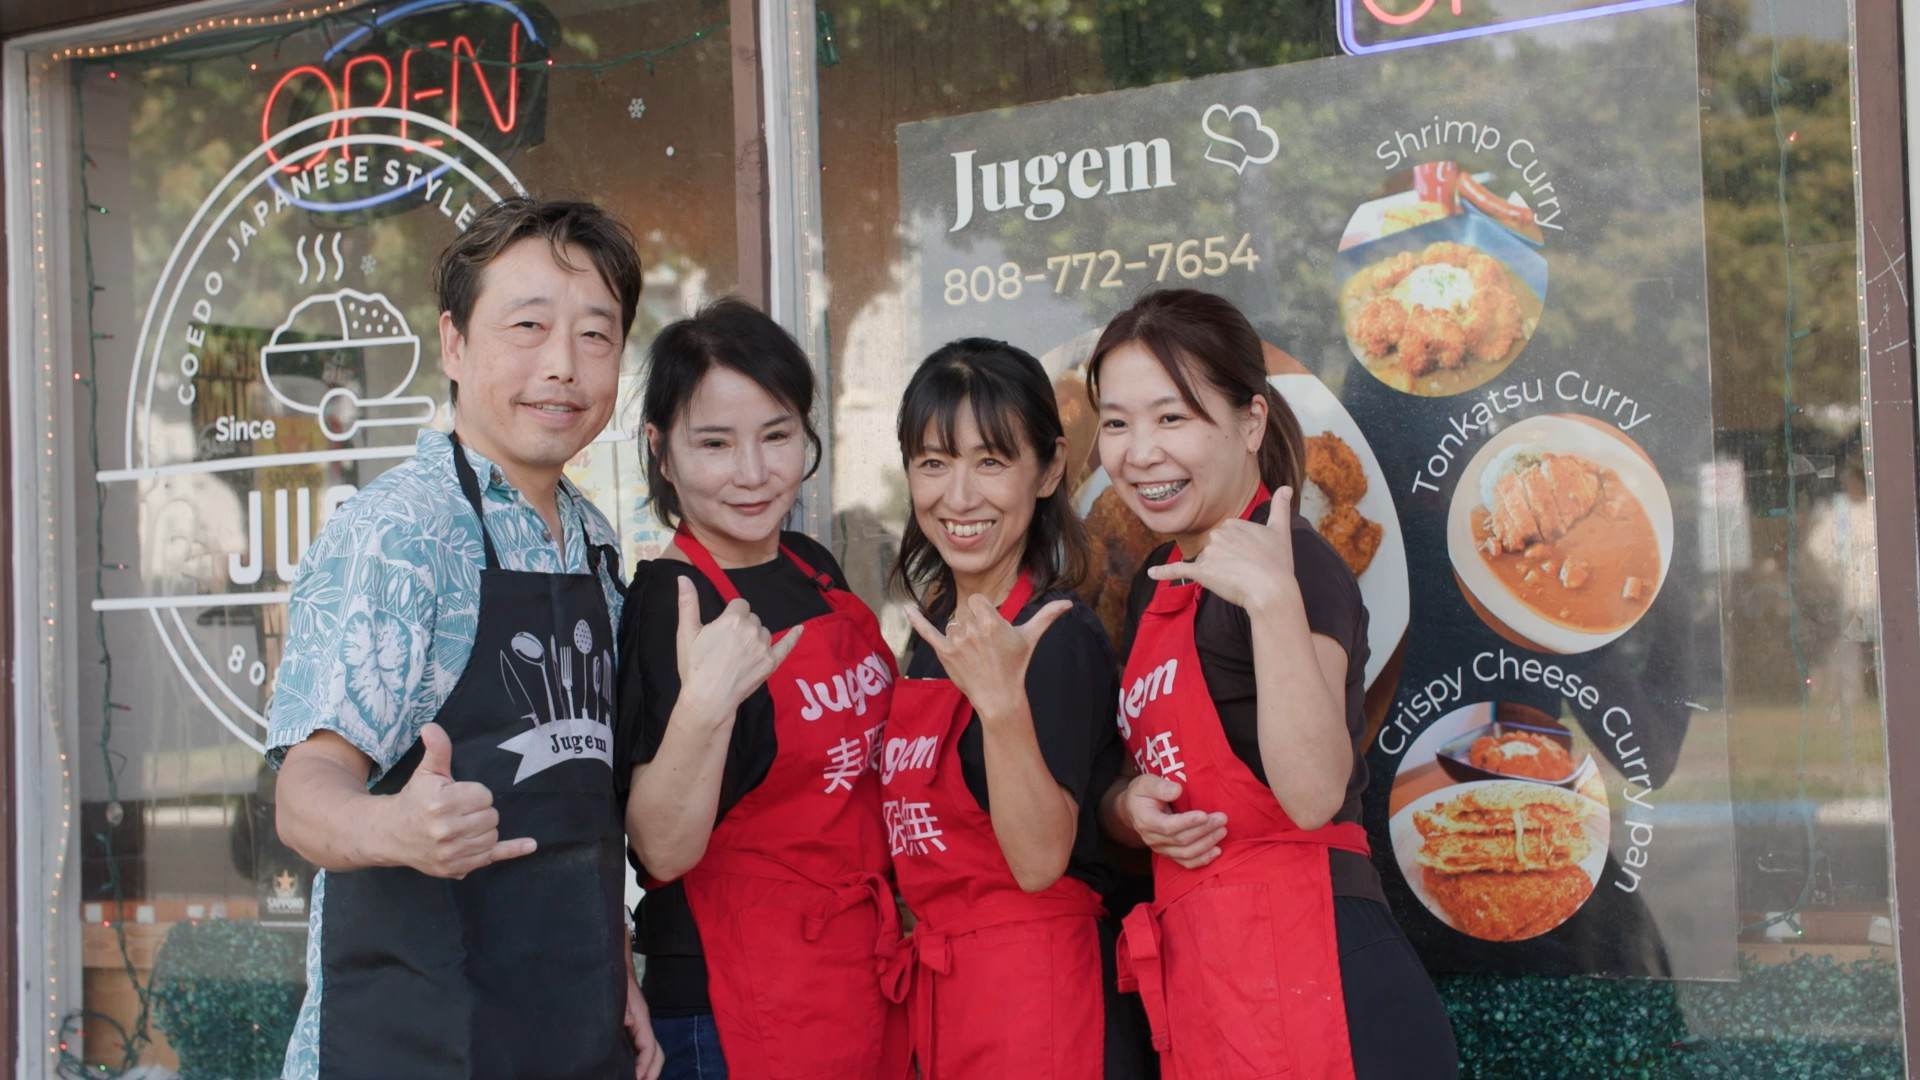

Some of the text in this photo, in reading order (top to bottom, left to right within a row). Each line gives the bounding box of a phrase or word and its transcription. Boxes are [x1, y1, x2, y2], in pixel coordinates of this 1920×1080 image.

[261, 21, 519, 174] OPEN
[949, 137, 1176, 232] Jugem
[1376, 115, 1564, 231] Shrimp Curry
[177, 156, 477, 405] COEDO JAPANESE STYLE
[943, 232, 1260, 306] 808-772-7654
[215, 415, 276, 442] Since
[1411, 371, 1652, 494] Tonkatsu Curry
[228, 485, 358, 585] JU
[550, 733, 607, 754] Jugem
[880, 735, 938, 785] gem
[1378, 648, 1655, 893] Crispy Cheese Curry pan
